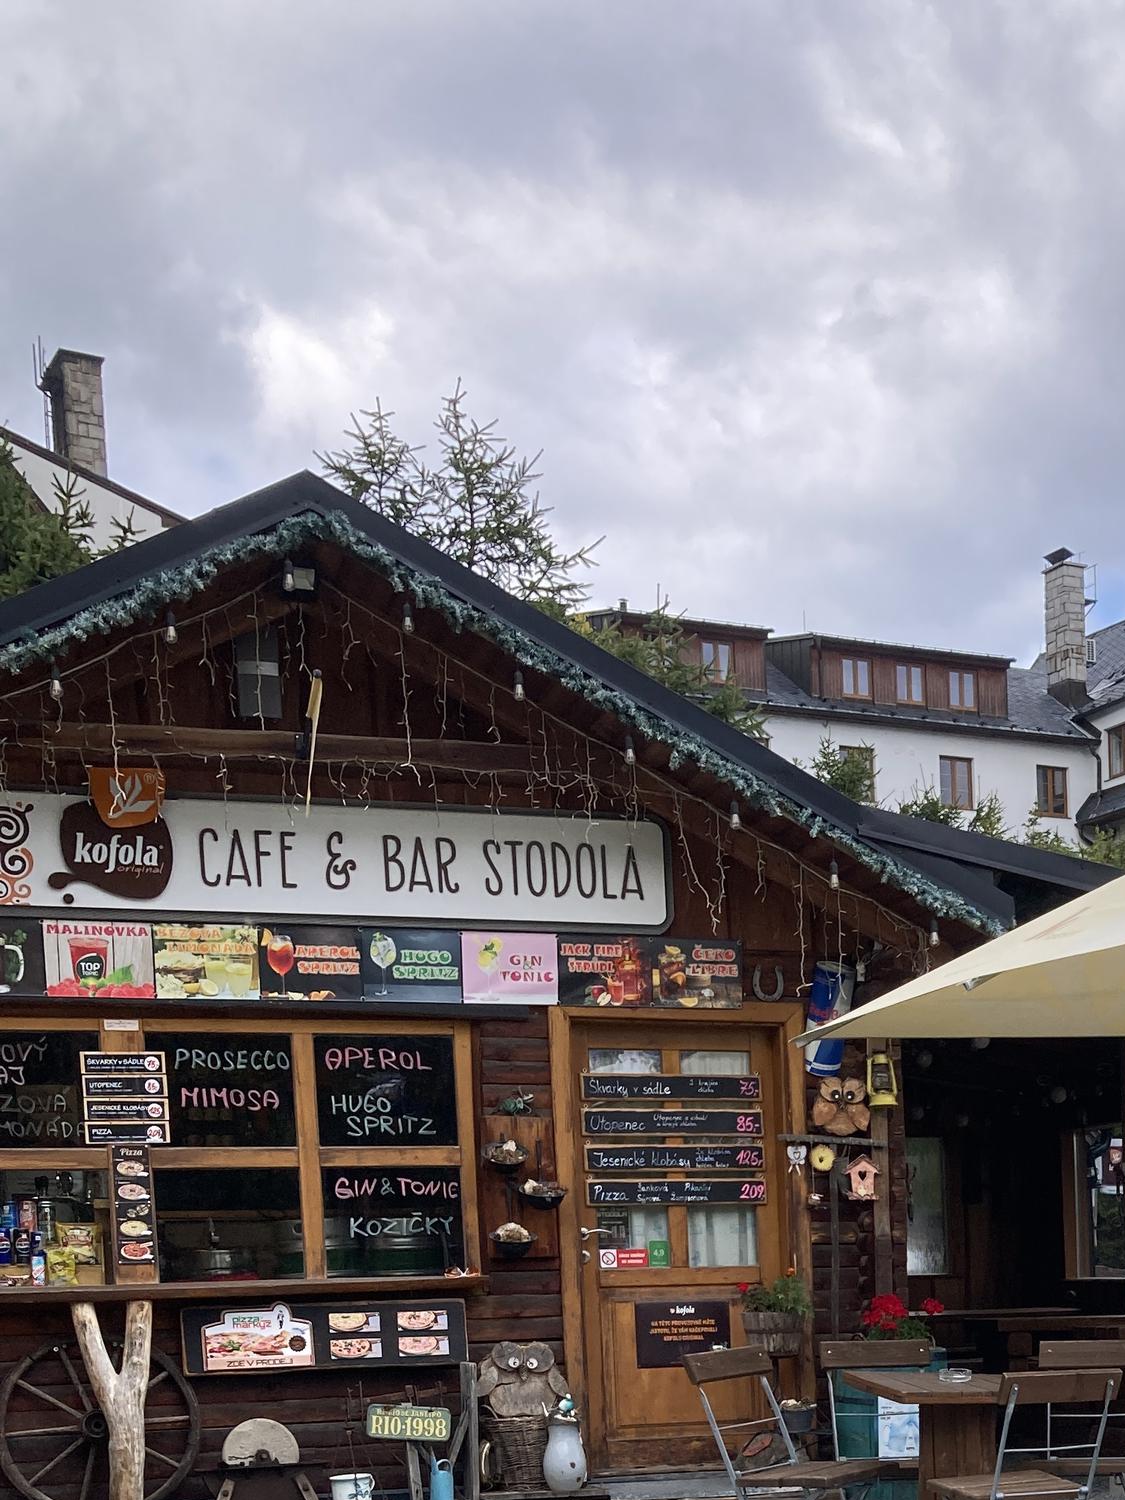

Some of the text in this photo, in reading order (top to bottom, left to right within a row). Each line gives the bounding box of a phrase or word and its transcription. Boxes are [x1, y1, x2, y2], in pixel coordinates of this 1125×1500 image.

[73, 832, 159, 873] kofola
[117, 863, 164, 878] original
[198, 828, 644, 901] CAFE & BAR STODOLA
[46, 924, 149, 937] MALINOVKA
[294, 945, 361, 959] APEROL
[400, 950, 451, 964] HUGO
[561, 944, 591, 956] JACK
[80, 962, 101, 971] TOP
[509, 954, 543, 967] GIN
[500, 972, 554, 982] TONIC
[174, 1048, 290, 1070] PROSECCO
[325, 1047, 432, 1070] APEROL
[589, 1078, 629, 1097] Škvarky
[642, 1081, 671, 1095] sádle
[181, 1087, 280, 1111] MIMOSA
[330, 1095, 392, 1115] HUGO
[346, 1115, 437, 1136] SPRITZ
[590, 1115, 646, 1132] Utopenec
[119, 1148, 143, 1156] Pizza
[592, 1150, 690, 1169] Jesenické klobásy
[334, 1177, 459, 1199] GIN & TONIC
[593, 1184, 629, 1201] Pizza
[349, 1212, 454, 1239] KOZIČKY
[675, 1305, 695, 1316] kofola
